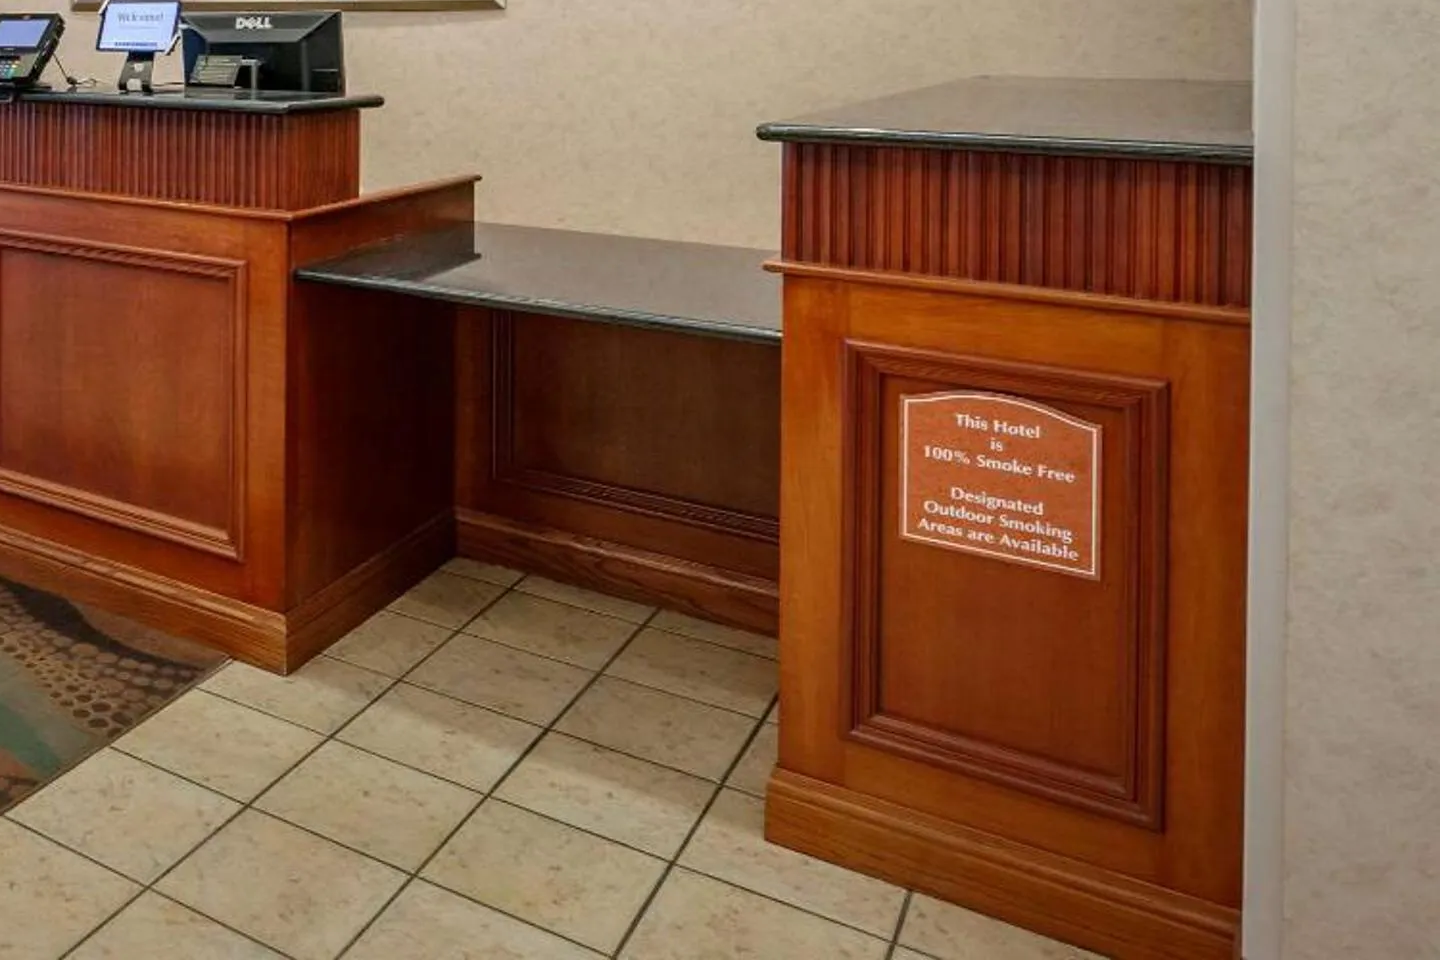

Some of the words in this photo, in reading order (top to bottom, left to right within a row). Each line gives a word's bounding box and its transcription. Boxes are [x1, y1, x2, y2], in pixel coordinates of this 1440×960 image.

[235, 16, 272, 29] DELL
[955, 413, 988, 431] This
[993, 419, 1040, 439] Hotel
[990, 437, 1003, 452] is
[924, 445, 970, 465] 100%
[976, 454, 1033, 476] Smoke
[1038, 466, 1076, 483] Free
[950, 487, 1044, 516] Designated
[924, 500, 994, 525] Outdoor
[999, 515, 1073, 544] Smoking
[917, 517, 963, 538] Areas
[967, 528, 994, 545] are
[999, 534, 1079, 561] Available
